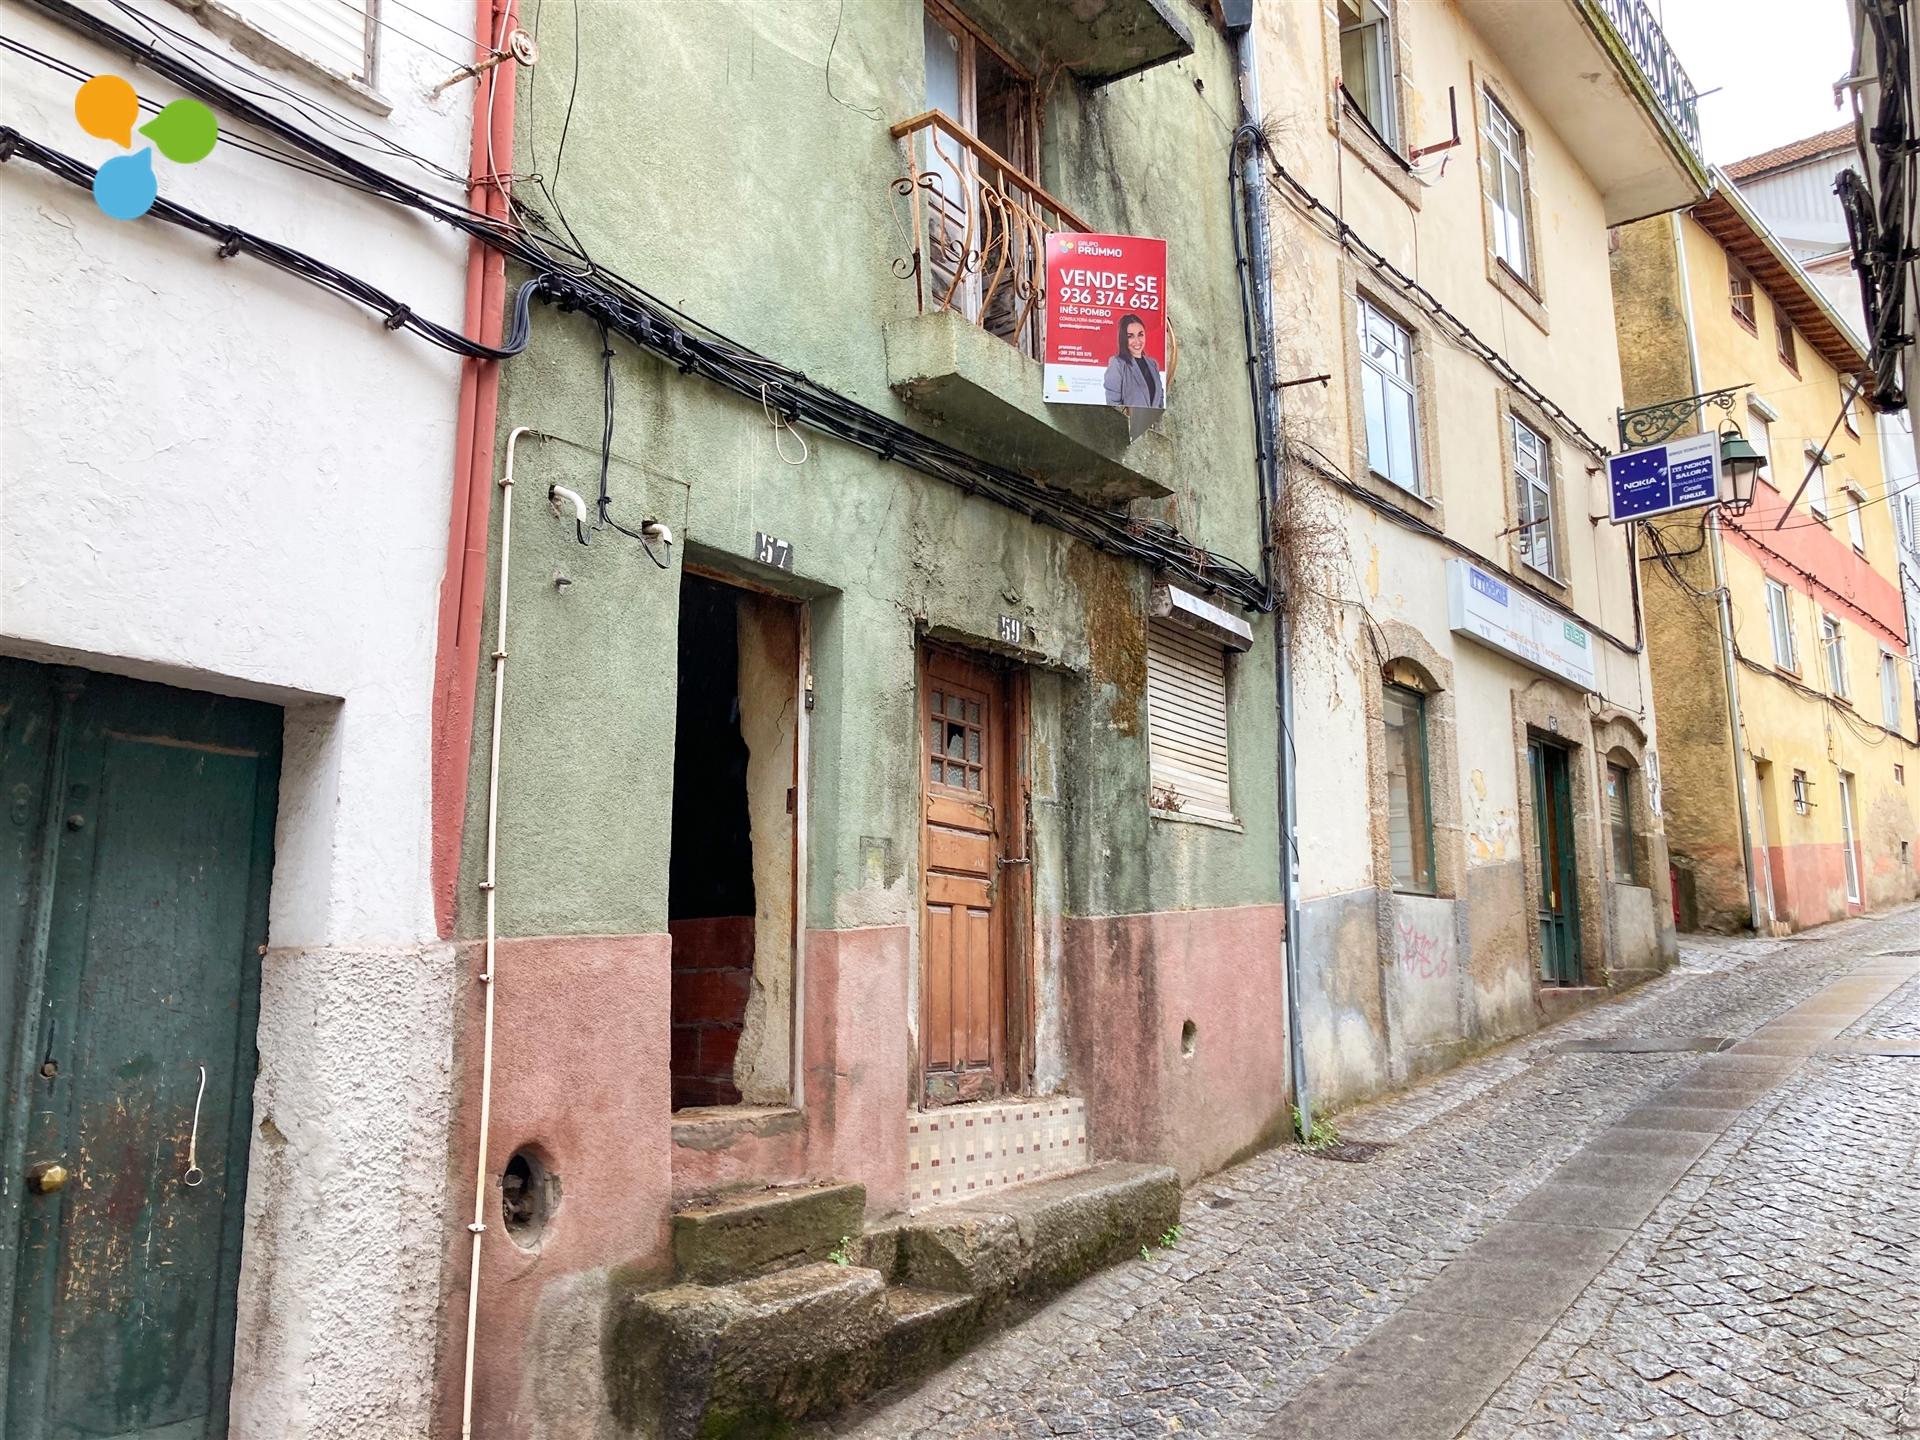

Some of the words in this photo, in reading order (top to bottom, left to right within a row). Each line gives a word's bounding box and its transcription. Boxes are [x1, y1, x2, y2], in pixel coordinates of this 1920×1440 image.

[1077, 240, 1099, 248] GRUPO
[1077, 246, 1123, 258] PRUMMO
[1059, 268, 1158, 294] VENDE-SE
[1059, 287, 1092, 304] 936
[1095, 290, 1126, 307] 374
[1129, 293, 1160, 311] 652
[1059, 304, 1079, 316] INÊS
[1080, 306, 1112, 318] POMBO
[1685, 459, 1711, 470] NOKIA
[1676, 468, 1708, 479] SALORA
[1624, 478, 1657, 490] NOKIA
[1680, 490, 1706, 501] FINLUX
[759, 532, 789, 570] 57
[1000, 616, 1020, 644] 59
